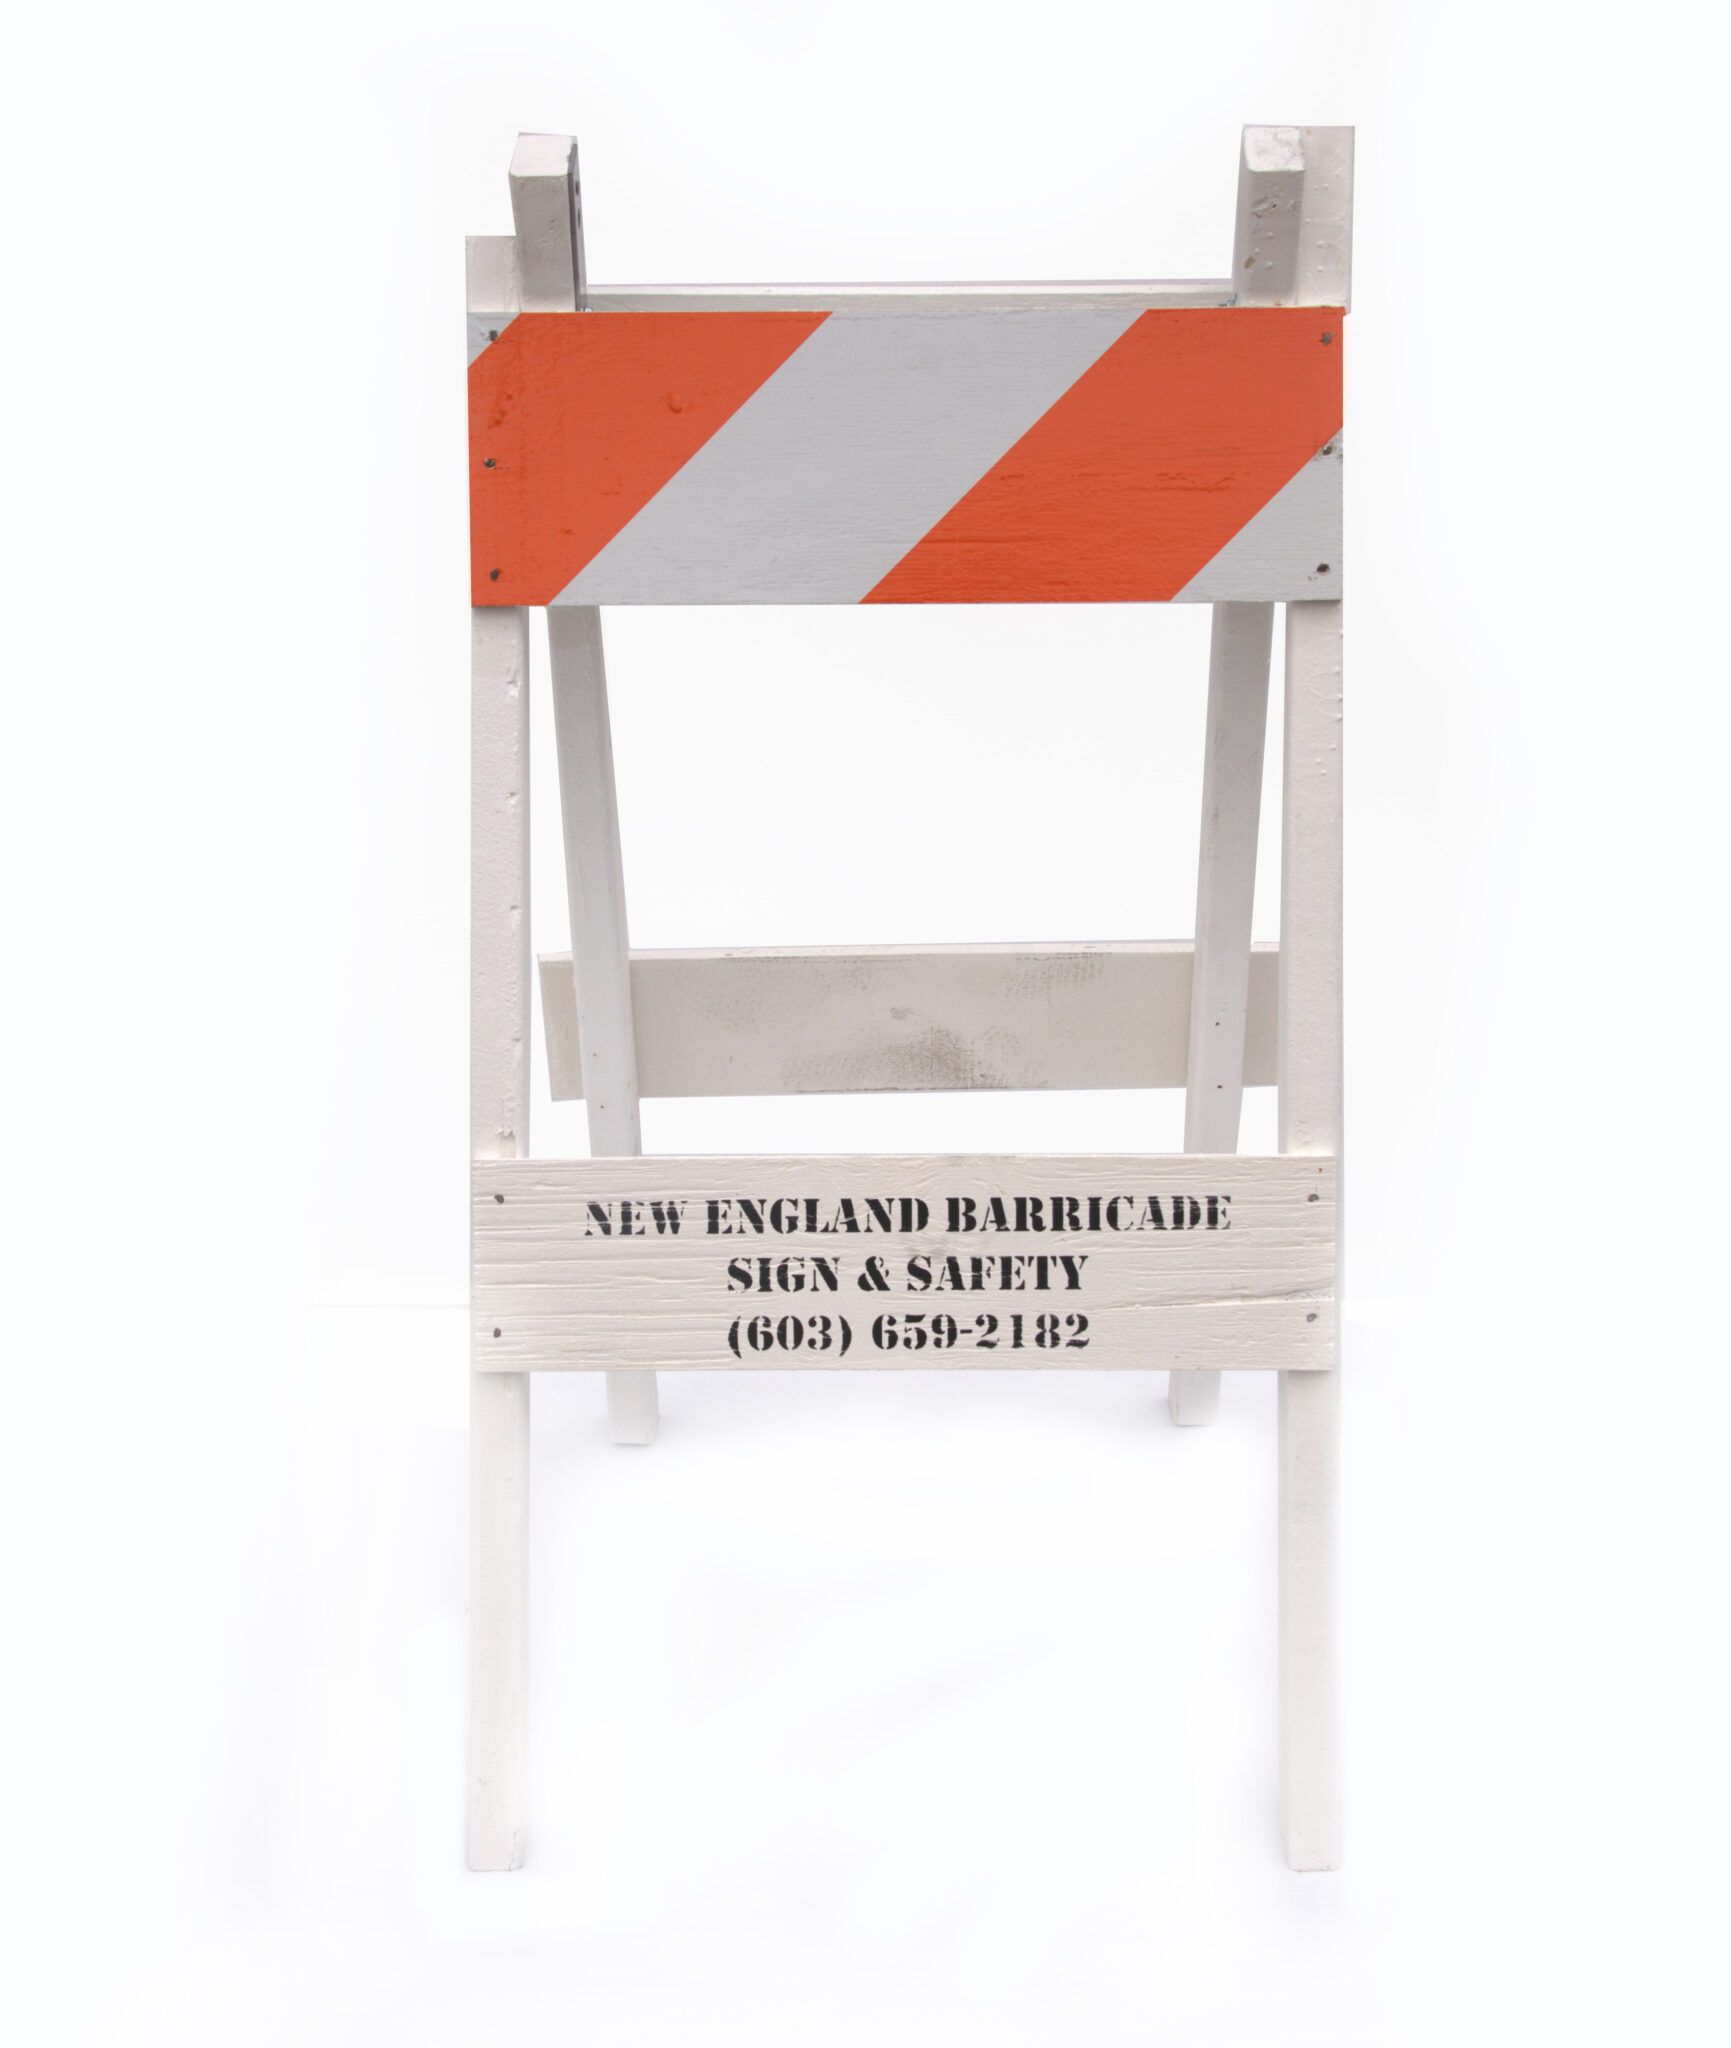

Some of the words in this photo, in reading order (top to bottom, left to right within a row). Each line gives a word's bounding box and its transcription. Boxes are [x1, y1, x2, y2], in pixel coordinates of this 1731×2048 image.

[584, 1200, 688, 1236] NEW
[705, 1197, 930, 1235] ENGLAND
[945, 1195, 1231, 1233] BARRICADE
[727, 1257, 840, 1293] SIGN
[857, 1256, 891, 1292] &
[907, 1255, 1089, 1292] SAFETY
[728, 1314, 852, 1359] (603)
[872, 1314, 1090, 1350] 659-2182
